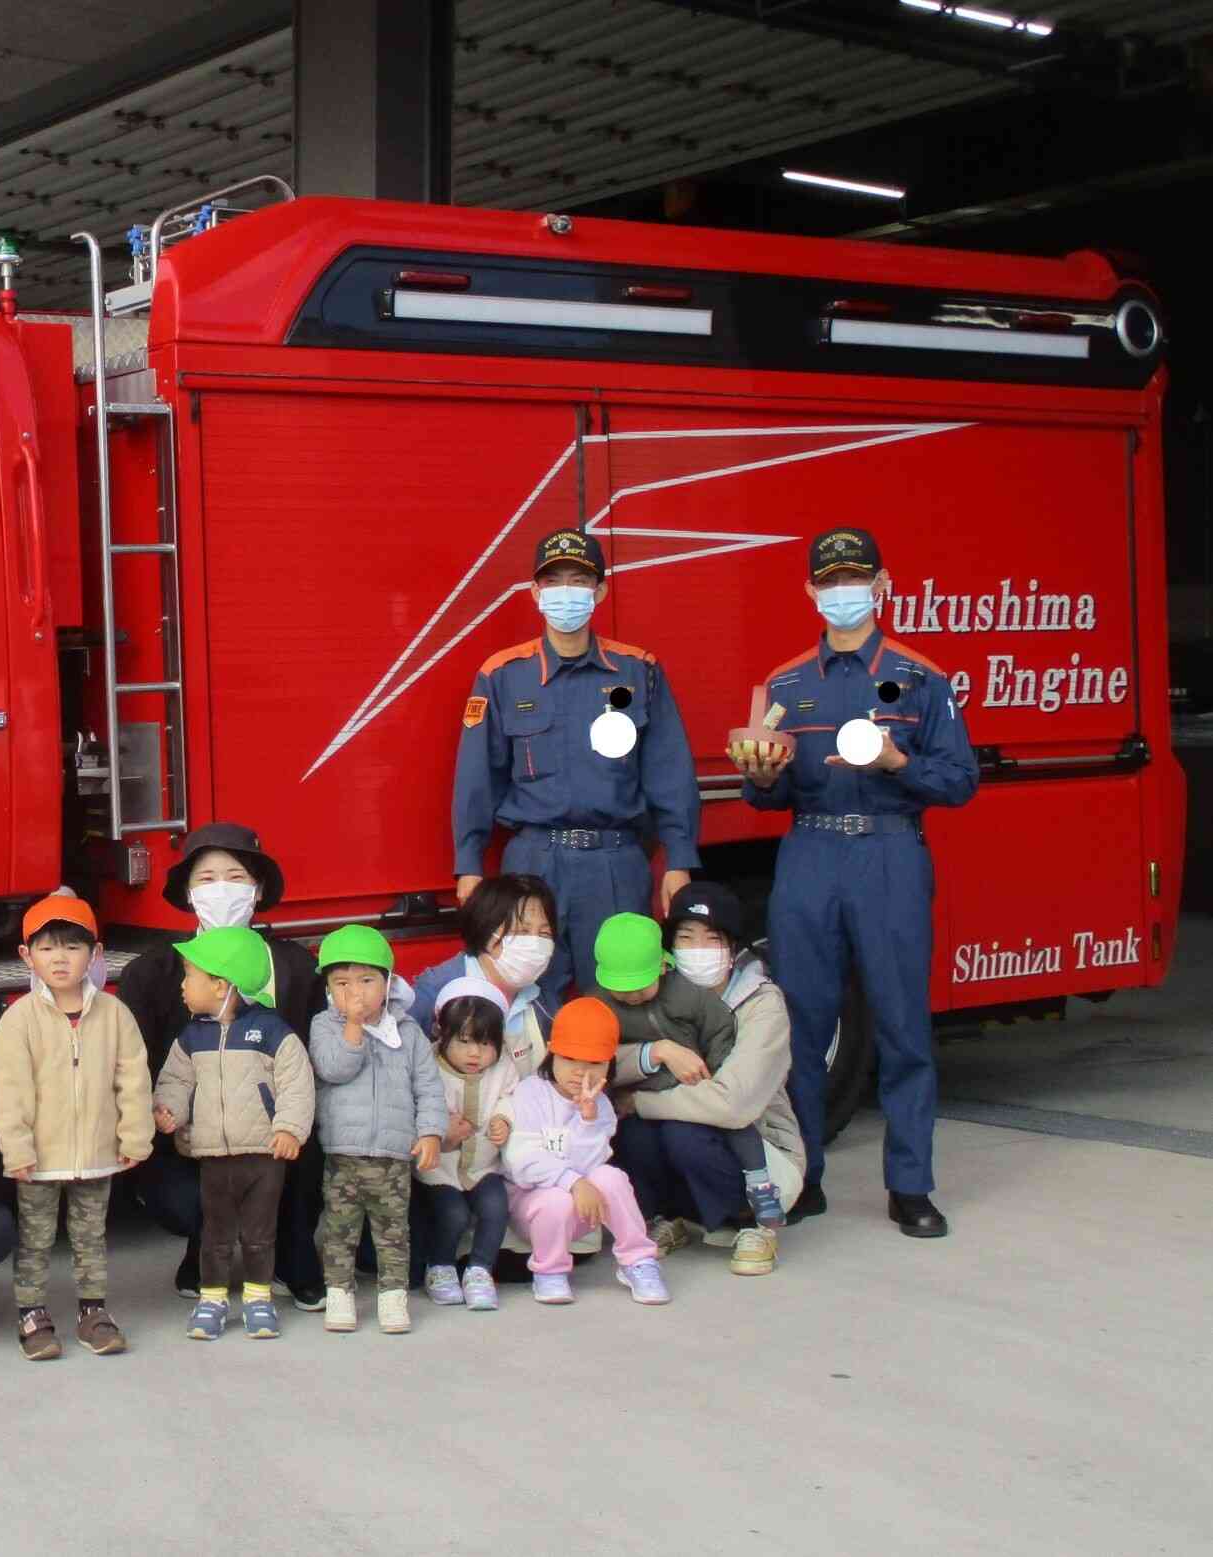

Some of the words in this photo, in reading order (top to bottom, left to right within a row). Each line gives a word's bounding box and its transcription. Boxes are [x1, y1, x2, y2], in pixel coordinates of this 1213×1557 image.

[982, 652, 1129, 713] Engine
[952, 937, 1062, 984] Shimizu
[1073, 926, 1142, 970] Tank
